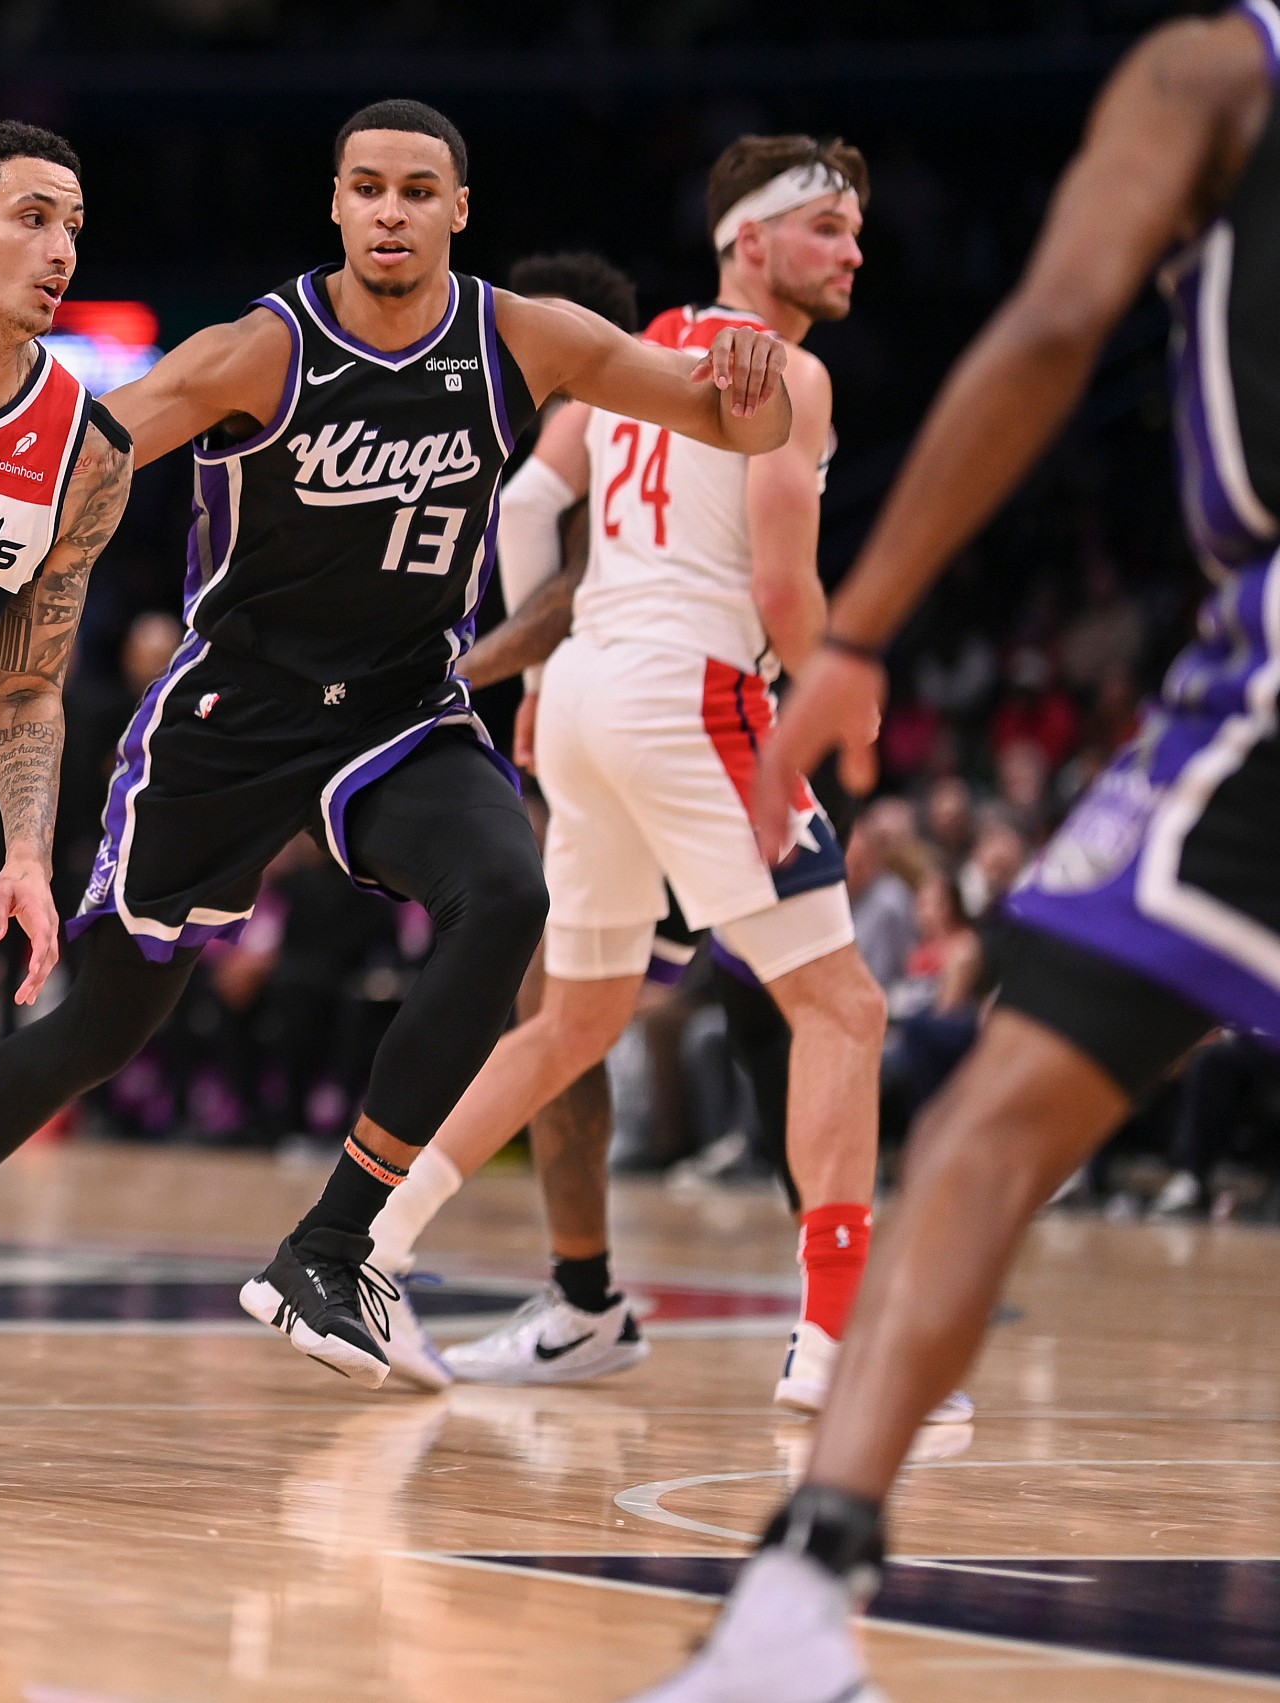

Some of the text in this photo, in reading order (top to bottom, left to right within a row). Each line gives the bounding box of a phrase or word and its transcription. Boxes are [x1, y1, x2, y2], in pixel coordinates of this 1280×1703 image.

[425, 356, 479, 373] dialpad
[287, 419, 481, 507] Kings
[603, 422, 671, 548] 24
[380, 505, 471, 576] 13
